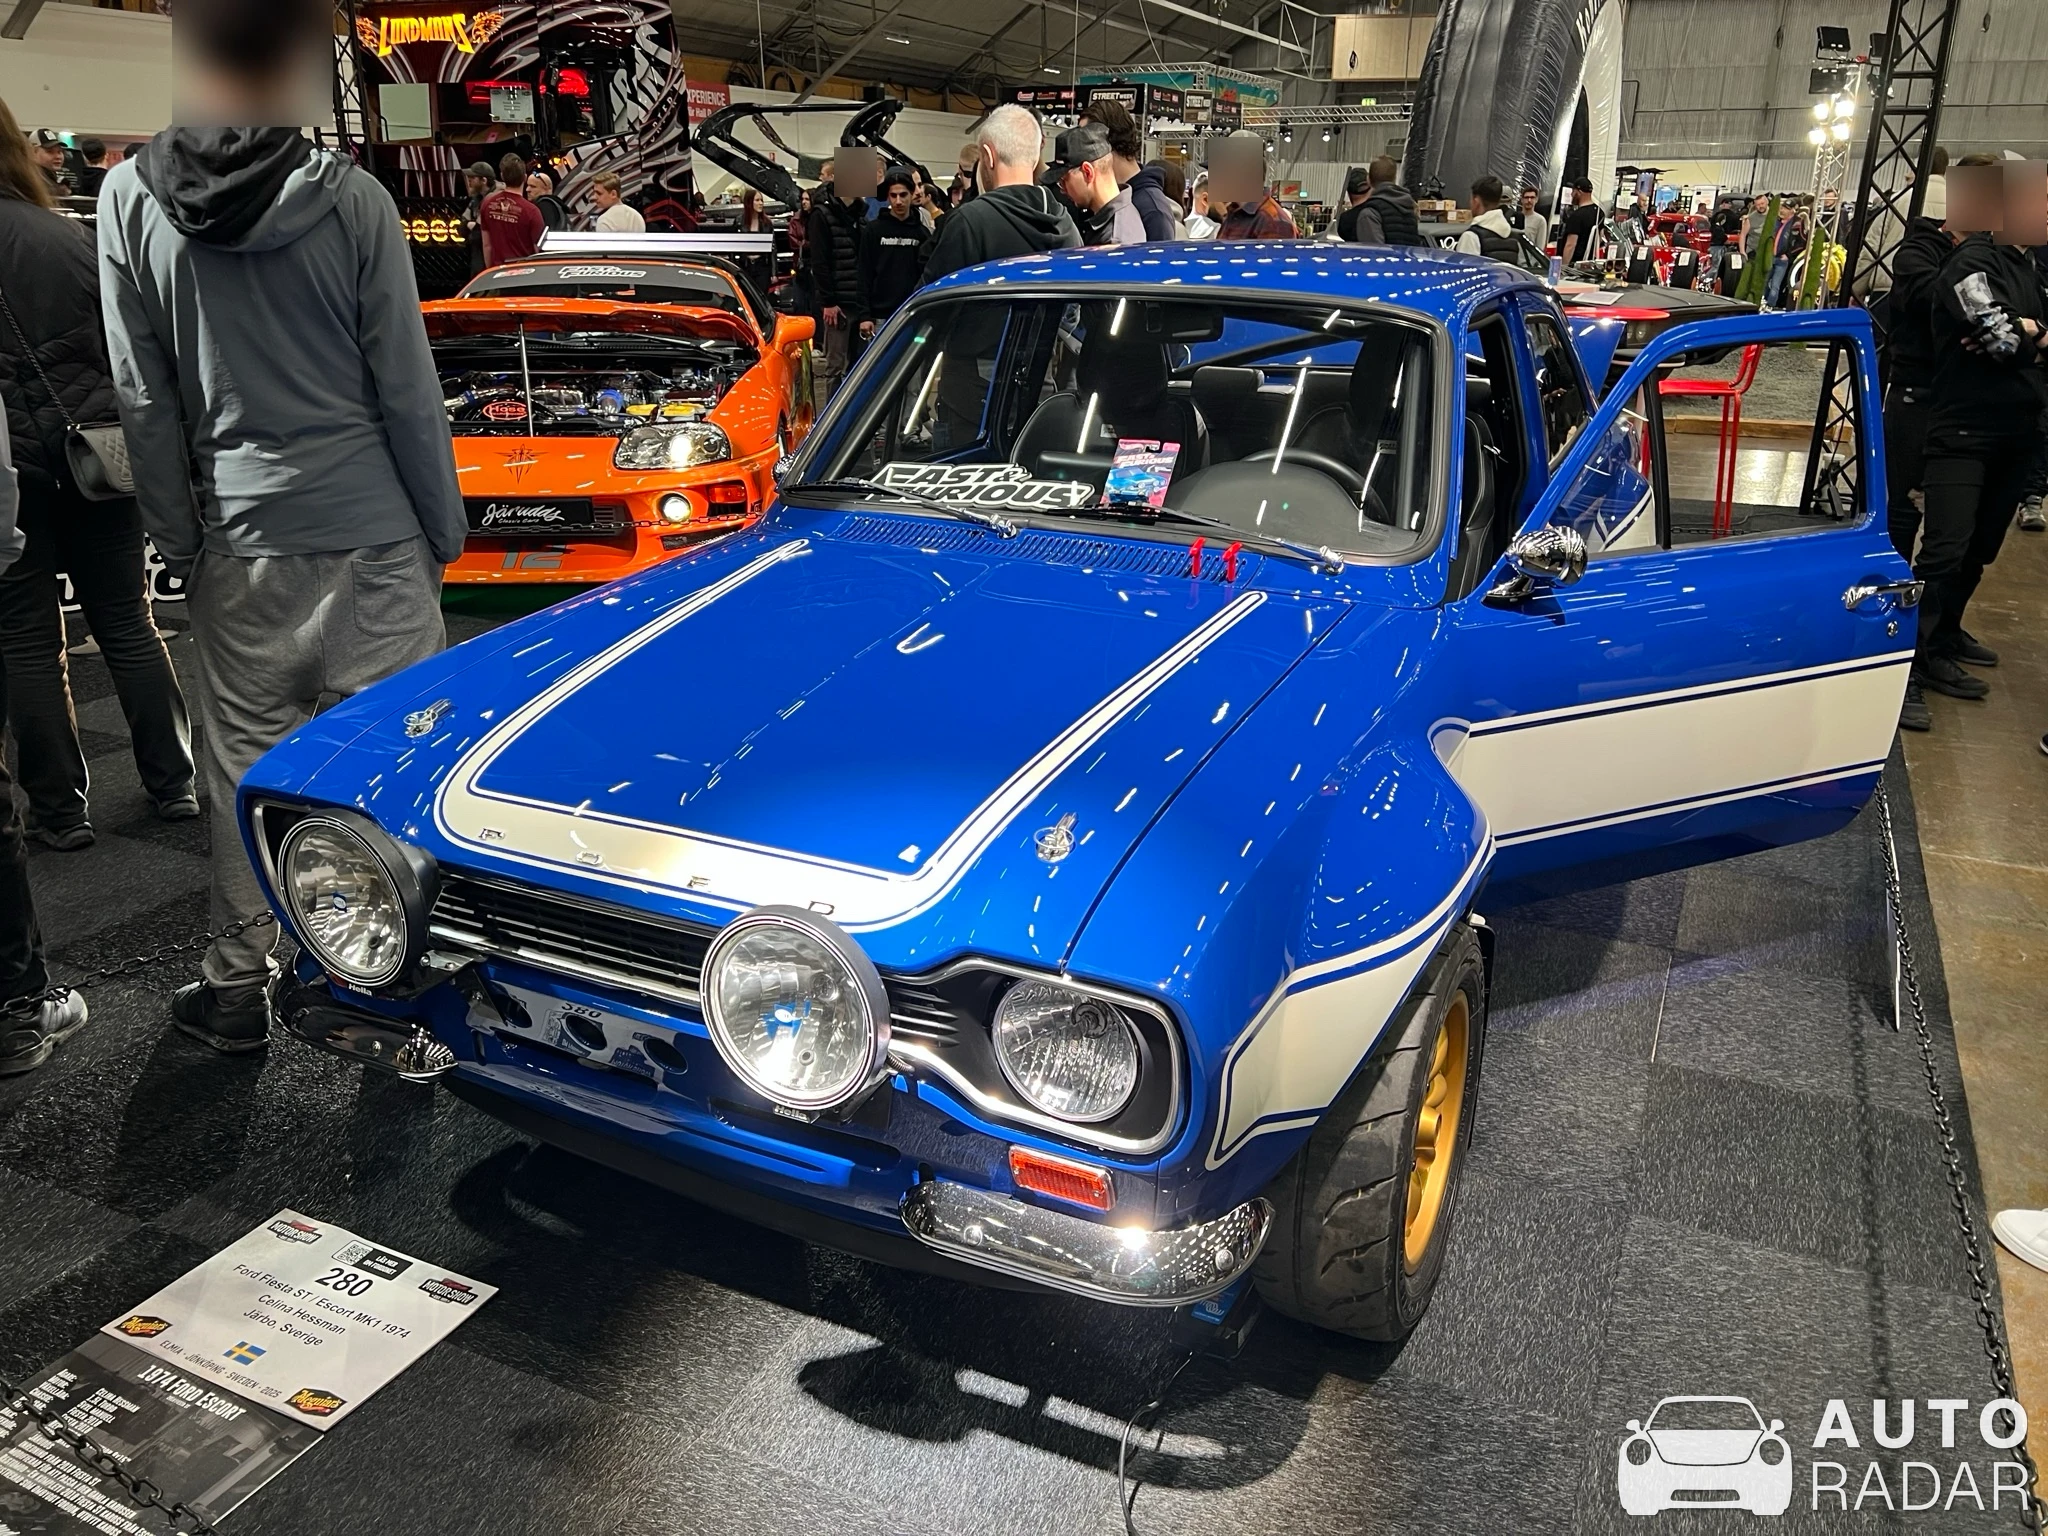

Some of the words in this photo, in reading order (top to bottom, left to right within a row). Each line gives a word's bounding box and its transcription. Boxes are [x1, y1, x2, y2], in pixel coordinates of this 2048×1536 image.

[378, 13, 475, 57] LUNDMANS
[685, 88, 726, 106] XPERIENCE
[1092, 92, 1120, 100] STREET
[871, 464, 1012, 486] FAST
[482, 504, 565, 525] Järudds
[348, 984, 373, 996] Hella
[774, 1105, 807, 1120] Hella
[314, 1267, 374, 1297] 280
[233, 1264, 262, 1278] Ford
[258, 1274, 293, 1293] Fiesta
[293, 1289, 313, 1299] ST
[315, 1298, 355, 1317] Escort
[352, 1312, 381, 1327] MK1
[381, 1323, 411, 1338] 1974
[258, 1294, 293, 1313] Celina
[292, 1308, 345, 1334] Hessman
[243, 1309, 276, 1328] Järbo,
[279, 1323, 323, 1345] Sverige
[159, 1340, 183, 1354] ELMIA
[184, 1354, 225, 1374] JÖNKÖPING
[226, 1371, 259, 1388] SWEDEN
[260, 1386, 282, 1398] 2025
[137, 1364, 178, 1388] 1974
[166, 1378, 204, 1402] FORD
[195, 1391, 247, 1421] ESCORT
